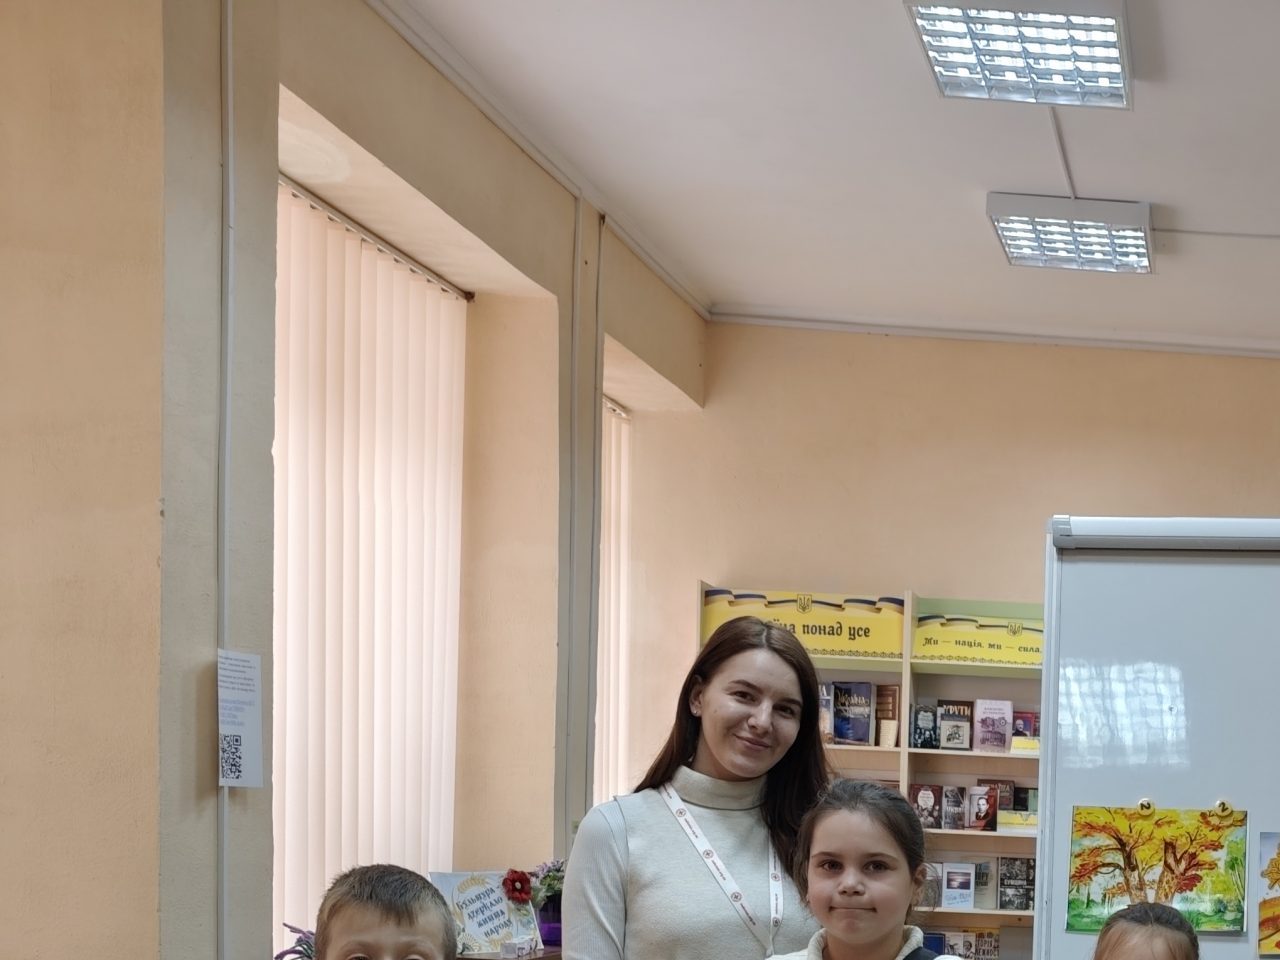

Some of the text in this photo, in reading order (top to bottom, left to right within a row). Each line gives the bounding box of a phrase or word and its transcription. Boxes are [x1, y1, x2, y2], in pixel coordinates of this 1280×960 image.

[802, 621, 842, 637] понад
[848, 626, 870, 640] усе
[923, 637, 938, 647] Ми
